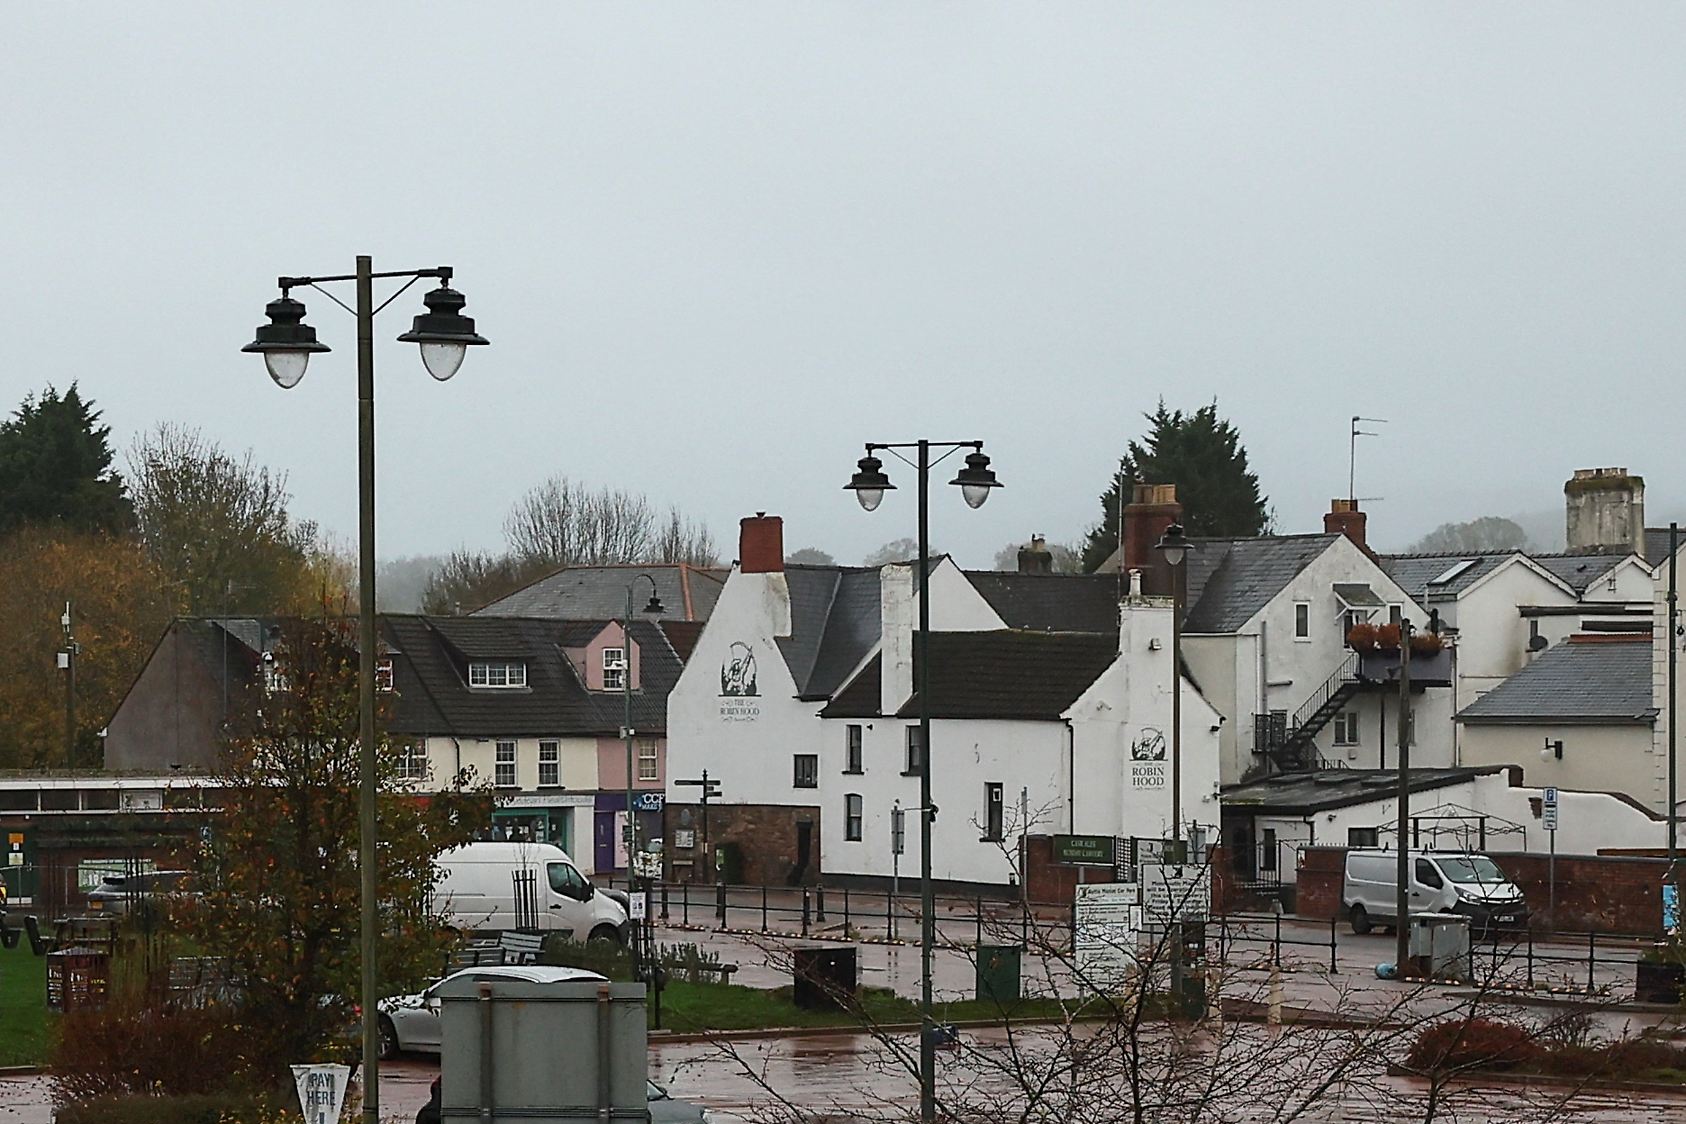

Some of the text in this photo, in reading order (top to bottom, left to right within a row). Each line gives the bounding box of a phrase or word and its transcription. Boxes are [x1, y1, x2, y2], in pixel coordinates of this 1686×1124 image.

[1132, 767, 1164, 776] ROBIN
[1132, 777, 1164, 786] HOOD
[310, 1073, 331, 1087] PAY
[307, 1091, 336, 1107] HERE
